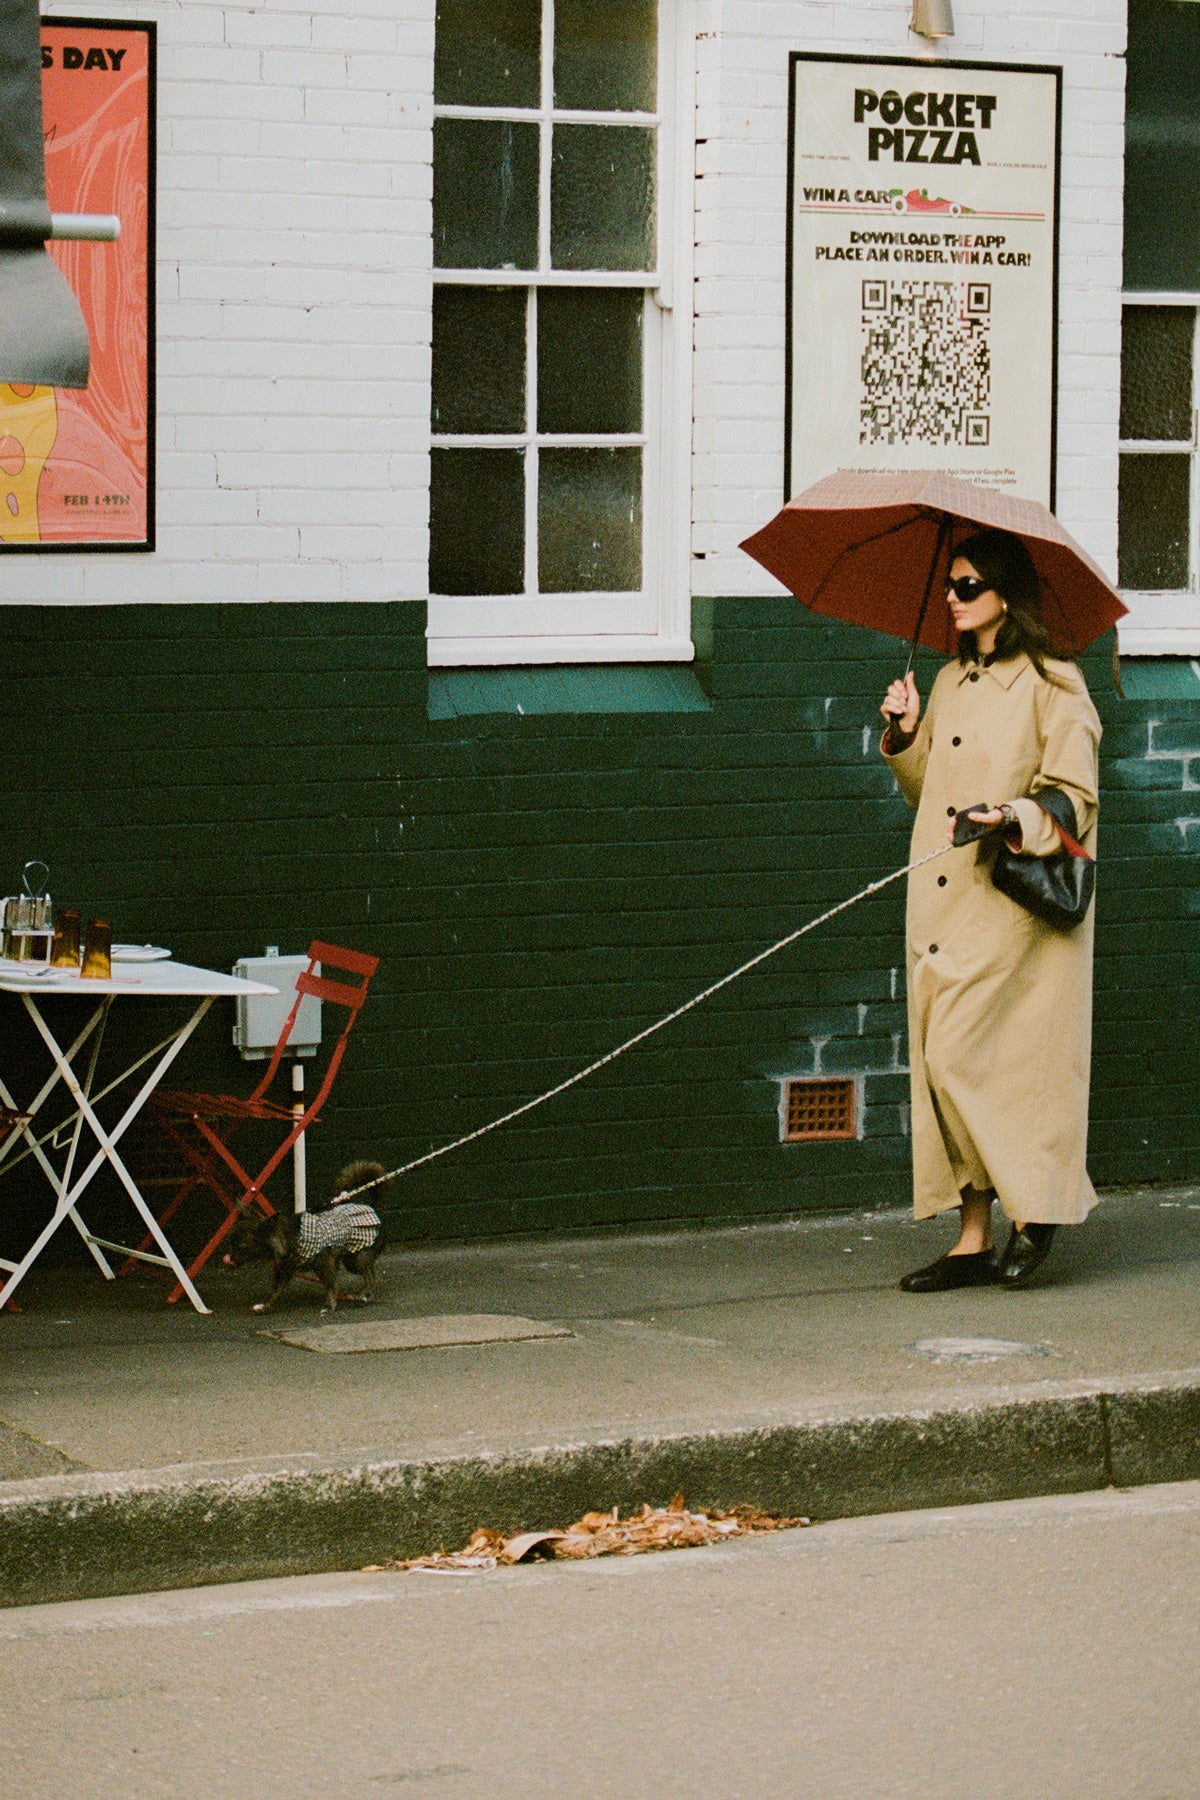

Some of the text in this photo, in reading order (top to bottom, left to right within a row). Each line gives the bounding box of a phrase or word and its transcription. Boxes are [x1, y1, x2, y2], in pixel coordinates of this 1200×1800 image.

[63, 46, 128, 71] DAY
[854, 88, 997, 129] POCKET
[868, 127, 981, 166] PIZZA
[803, 187, 835, 202] WIN
[838, 189, 850, 202] A
[850, 231, 1006, 248] DOWNLOAD THE APP
[815, 246, 1031, 267] PLACE AN ORDER. WIN A CAR!
[64, 495, 130, 506] FEB 14TH
